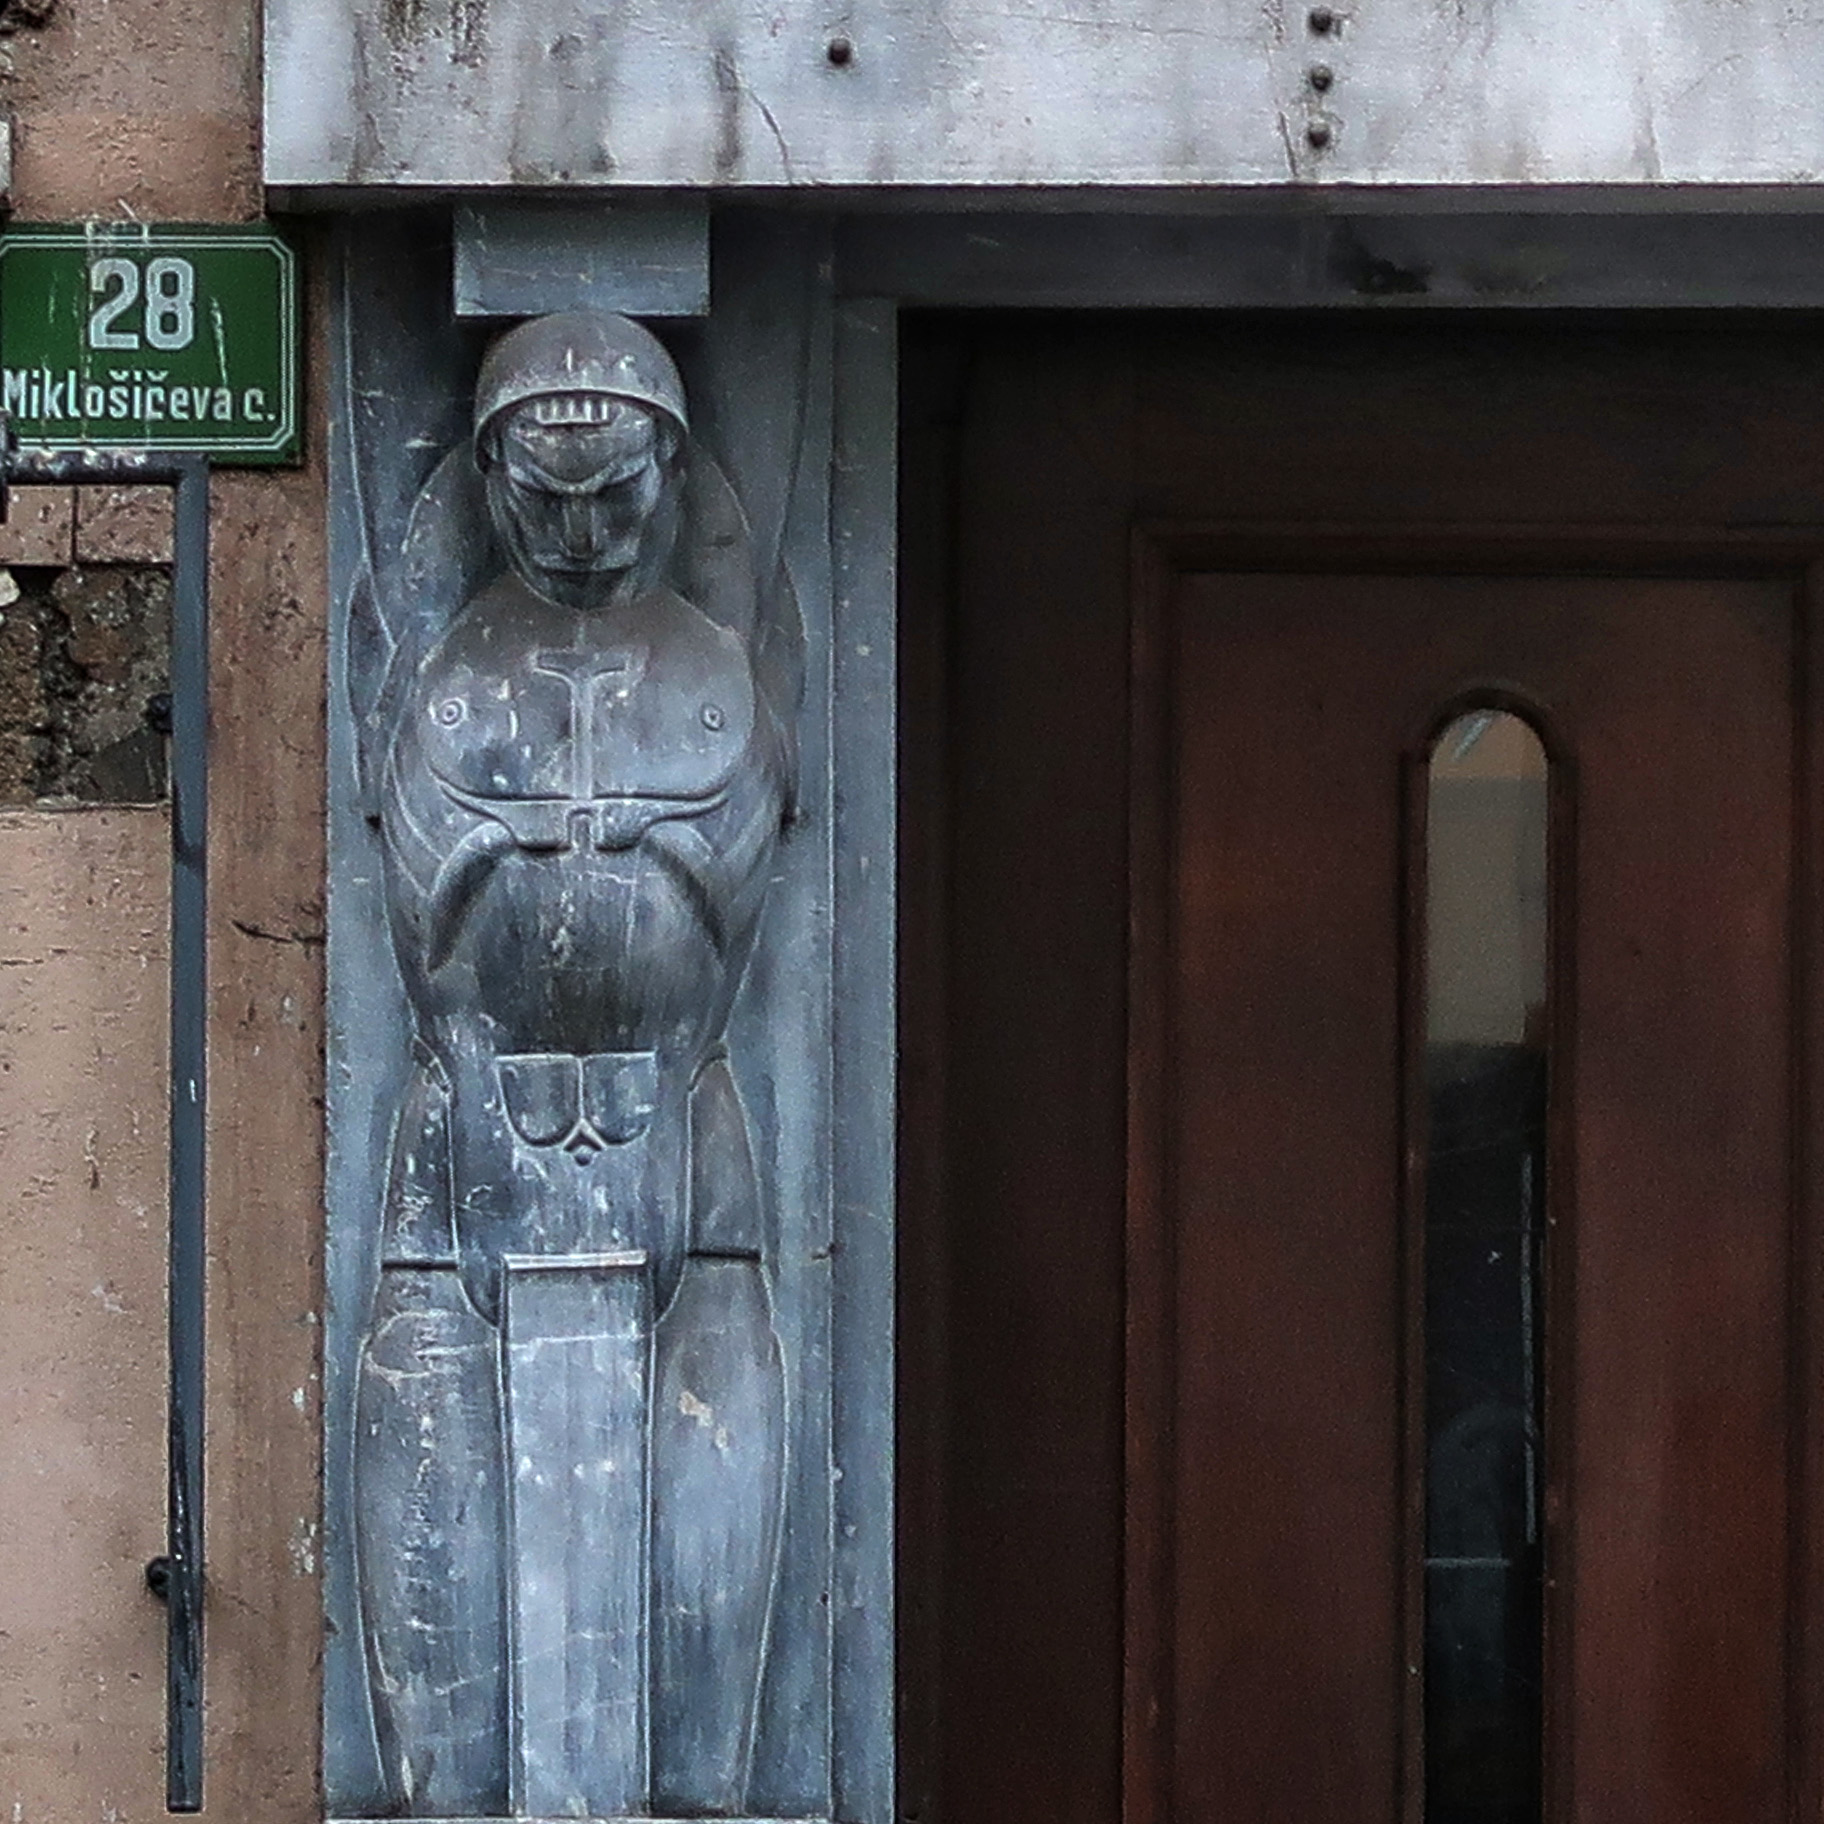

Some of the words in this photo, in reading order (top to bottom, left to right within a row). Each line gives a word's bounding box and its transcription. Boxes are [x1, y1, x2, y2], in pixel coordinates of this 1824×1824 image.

[90, 257, 194, 350] 28
[3, 366, 232, 420] Miklošičeva
[243, 387, 276, 421] c.
